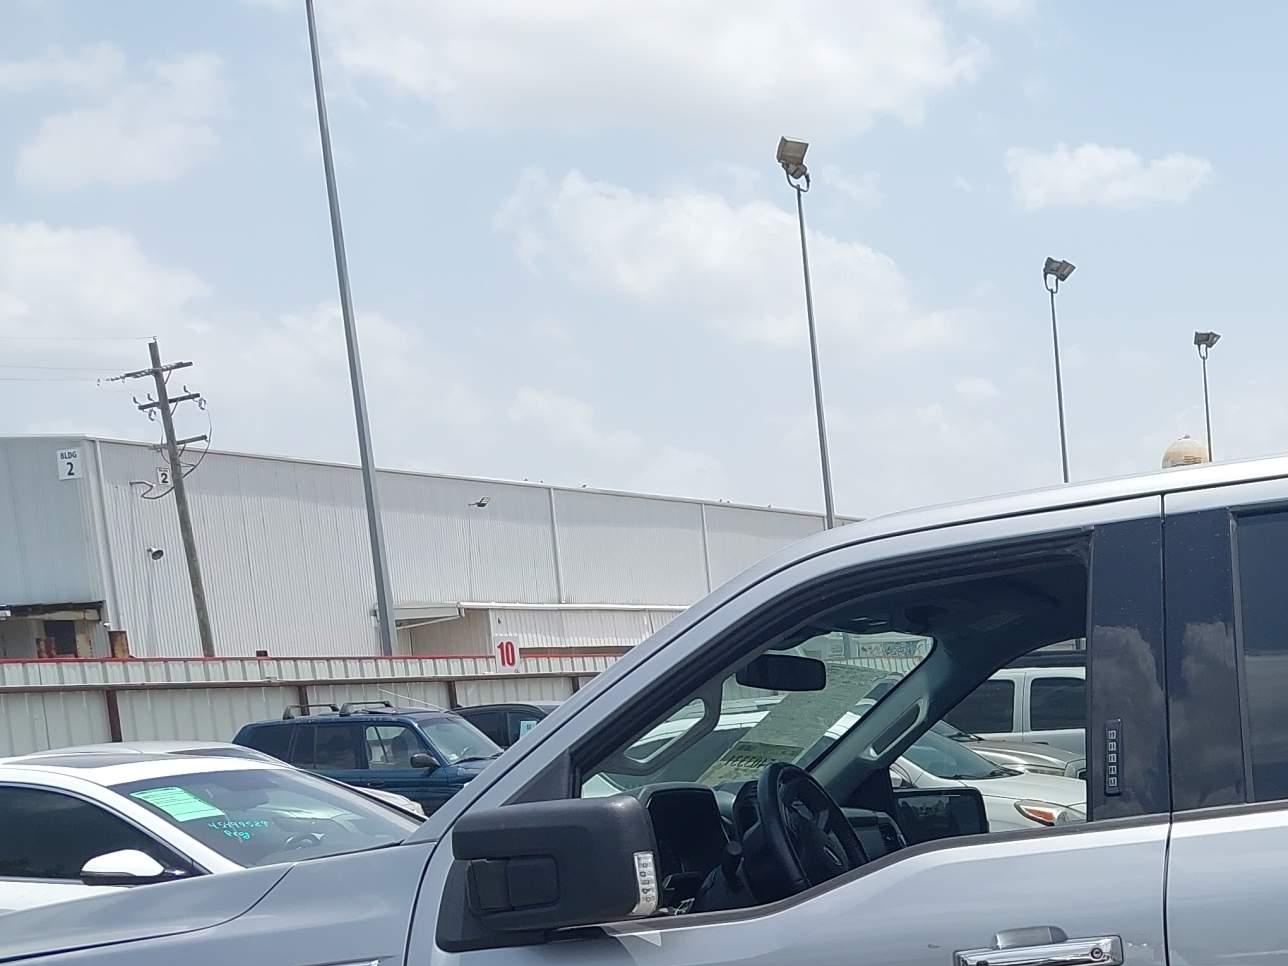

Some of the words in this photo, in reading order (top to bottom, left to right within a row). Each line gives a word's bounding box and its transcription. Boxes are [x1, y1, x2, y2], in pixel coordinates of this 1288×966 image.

[60, 451, 77, 459] BLDG
[66, 462, 75, 476] 2
[160, 472, 168, 483] 2
[497, 641, 515, 666] 10
